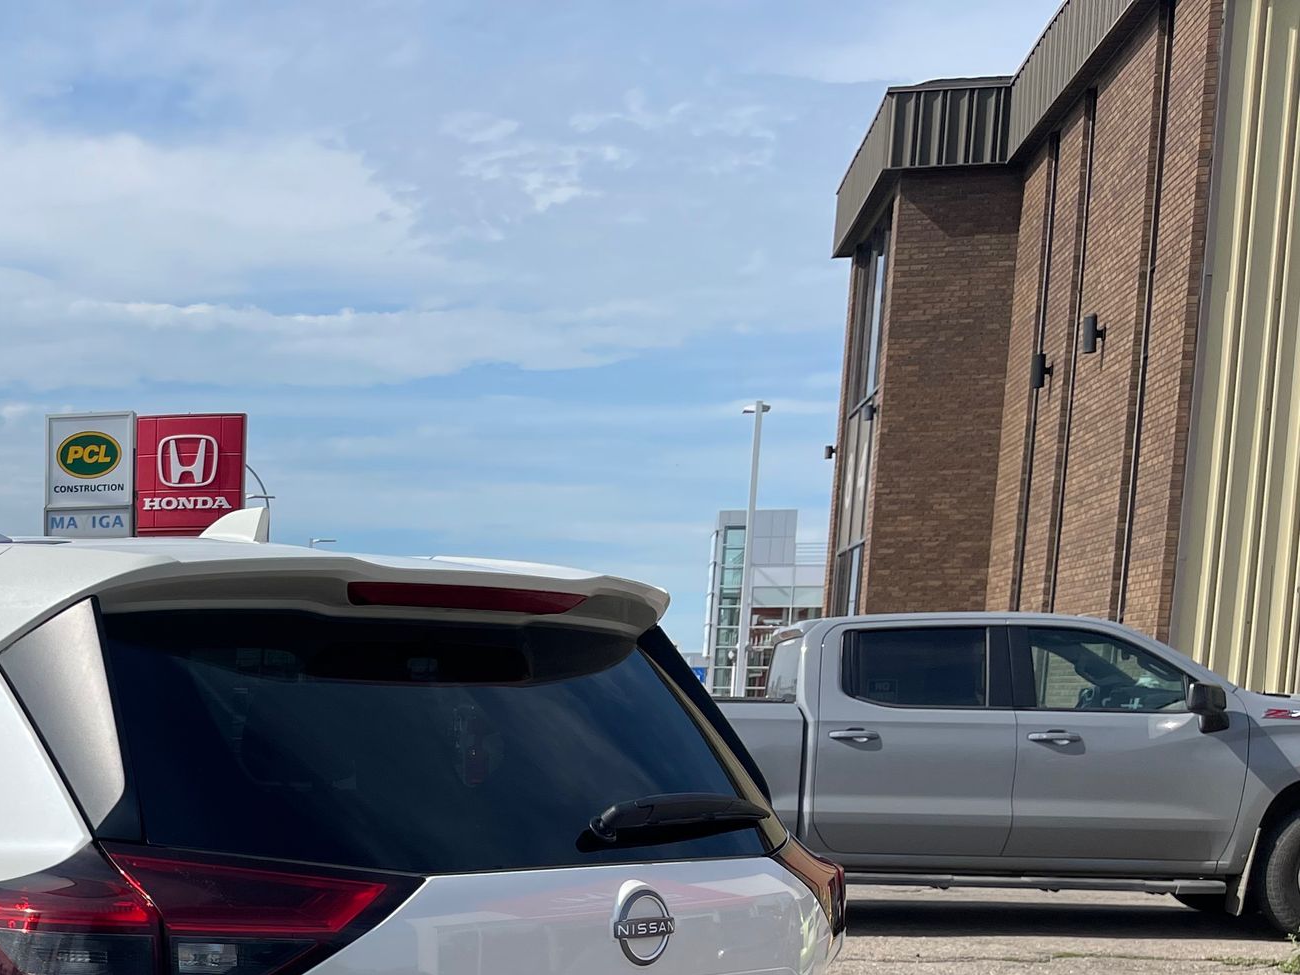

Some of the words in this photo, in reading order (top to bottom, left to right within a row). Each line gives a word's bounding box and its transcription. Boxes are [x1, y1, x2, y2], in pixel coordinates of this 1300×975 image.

[66, 444, 112, 464] PCL
[53, 483, 125, 494] CONSTRUCTION
[142, 496, 232, 511] HONDA
[617, 920, 674, 936] NISSAN
